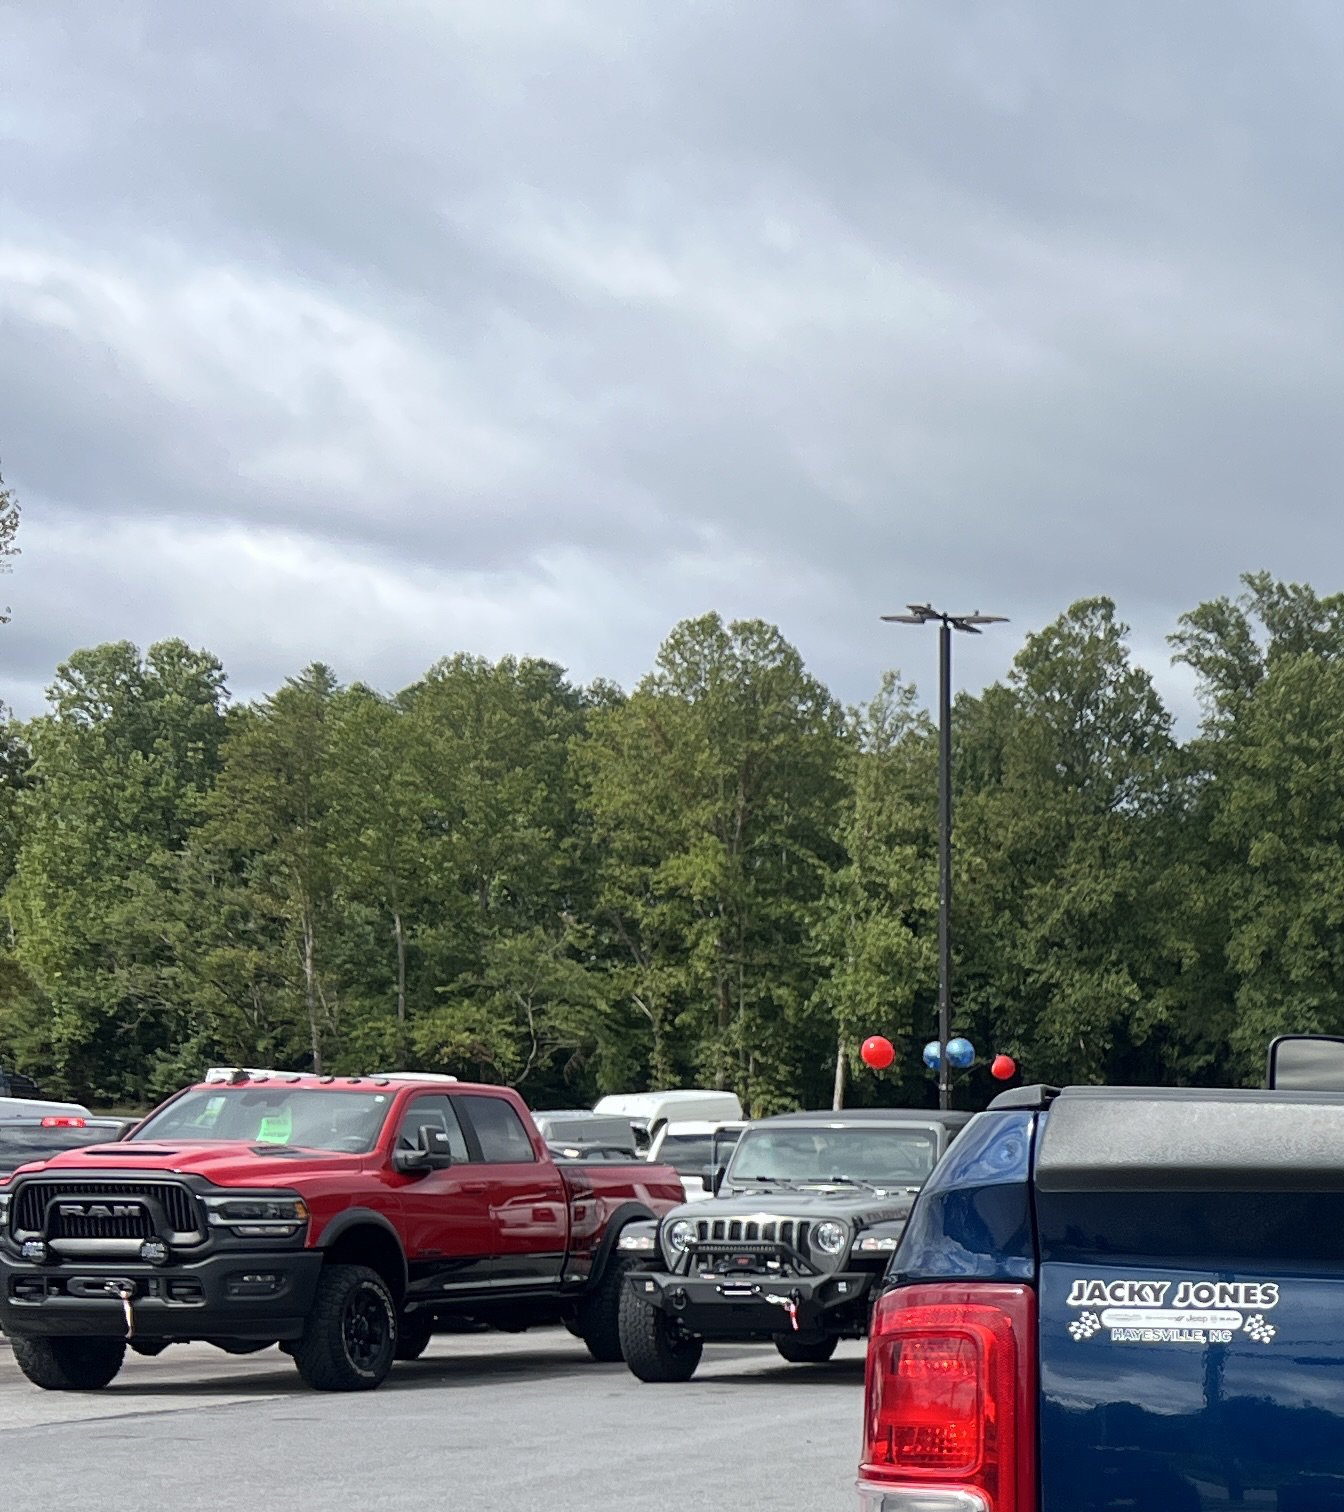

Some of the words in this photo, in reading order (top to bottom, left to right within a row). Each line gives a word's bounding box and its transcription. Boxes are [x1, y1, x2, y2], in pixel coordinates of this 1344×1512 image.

[60, 1204, 141, 1217] RAM
[1066, 1280, 1171, 1306] JACKY
[1172, 1281, 1279, 1308] JONES
[1111, 1328, 1207, 1343] HAYESVILLE,
[1209, 1330, 1233, 1342] NC
